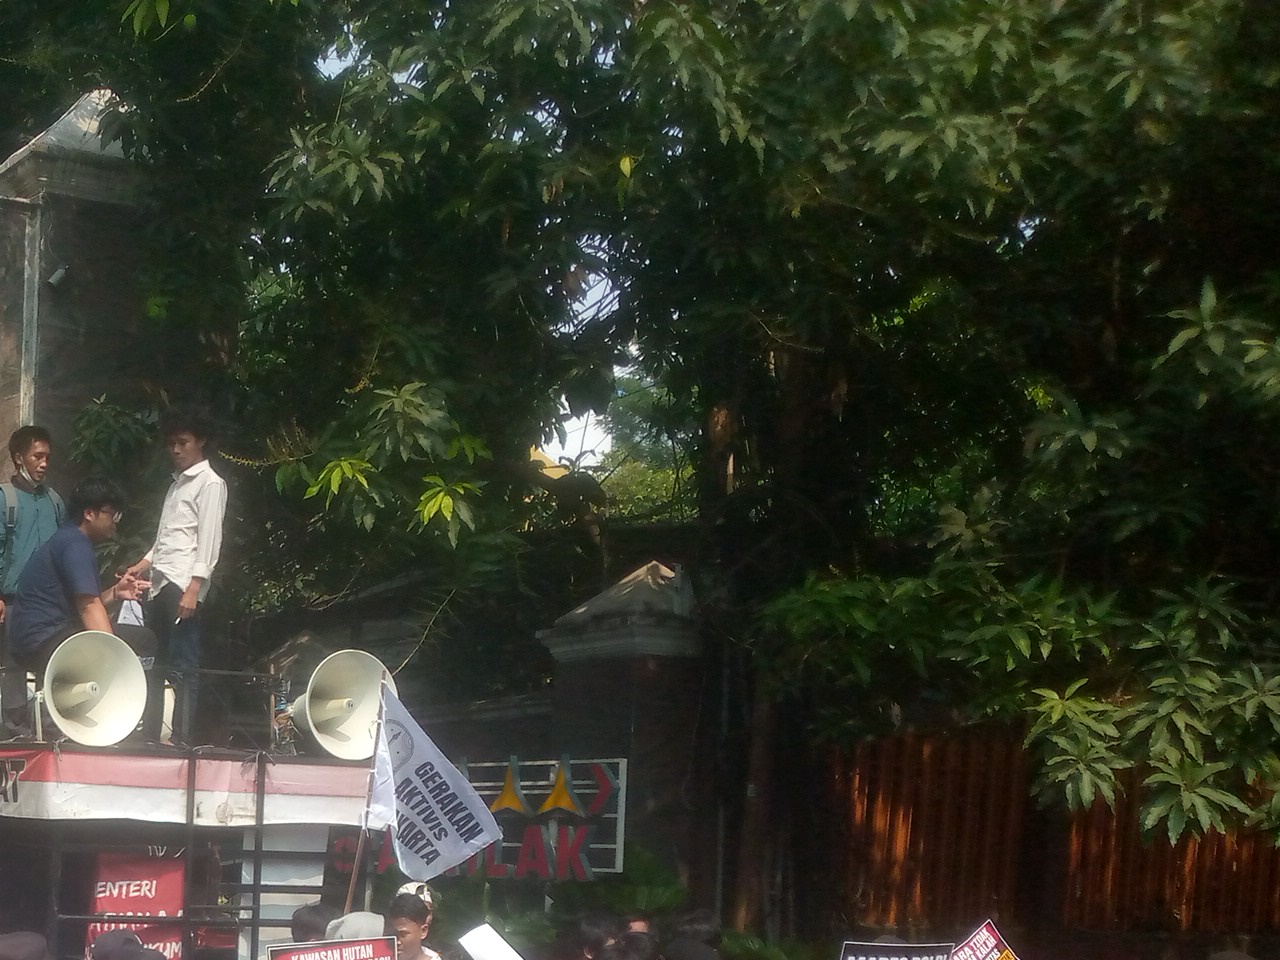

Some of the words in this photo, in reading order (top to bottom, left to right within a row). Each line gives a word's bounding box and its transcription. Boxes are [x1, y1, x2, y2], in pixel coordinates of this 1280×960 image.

[395, 777, 448, 842] AKTIVIS
[415, 761, 483, 844] GERAKAN
[343, 944, 373, 960] HUTAN
